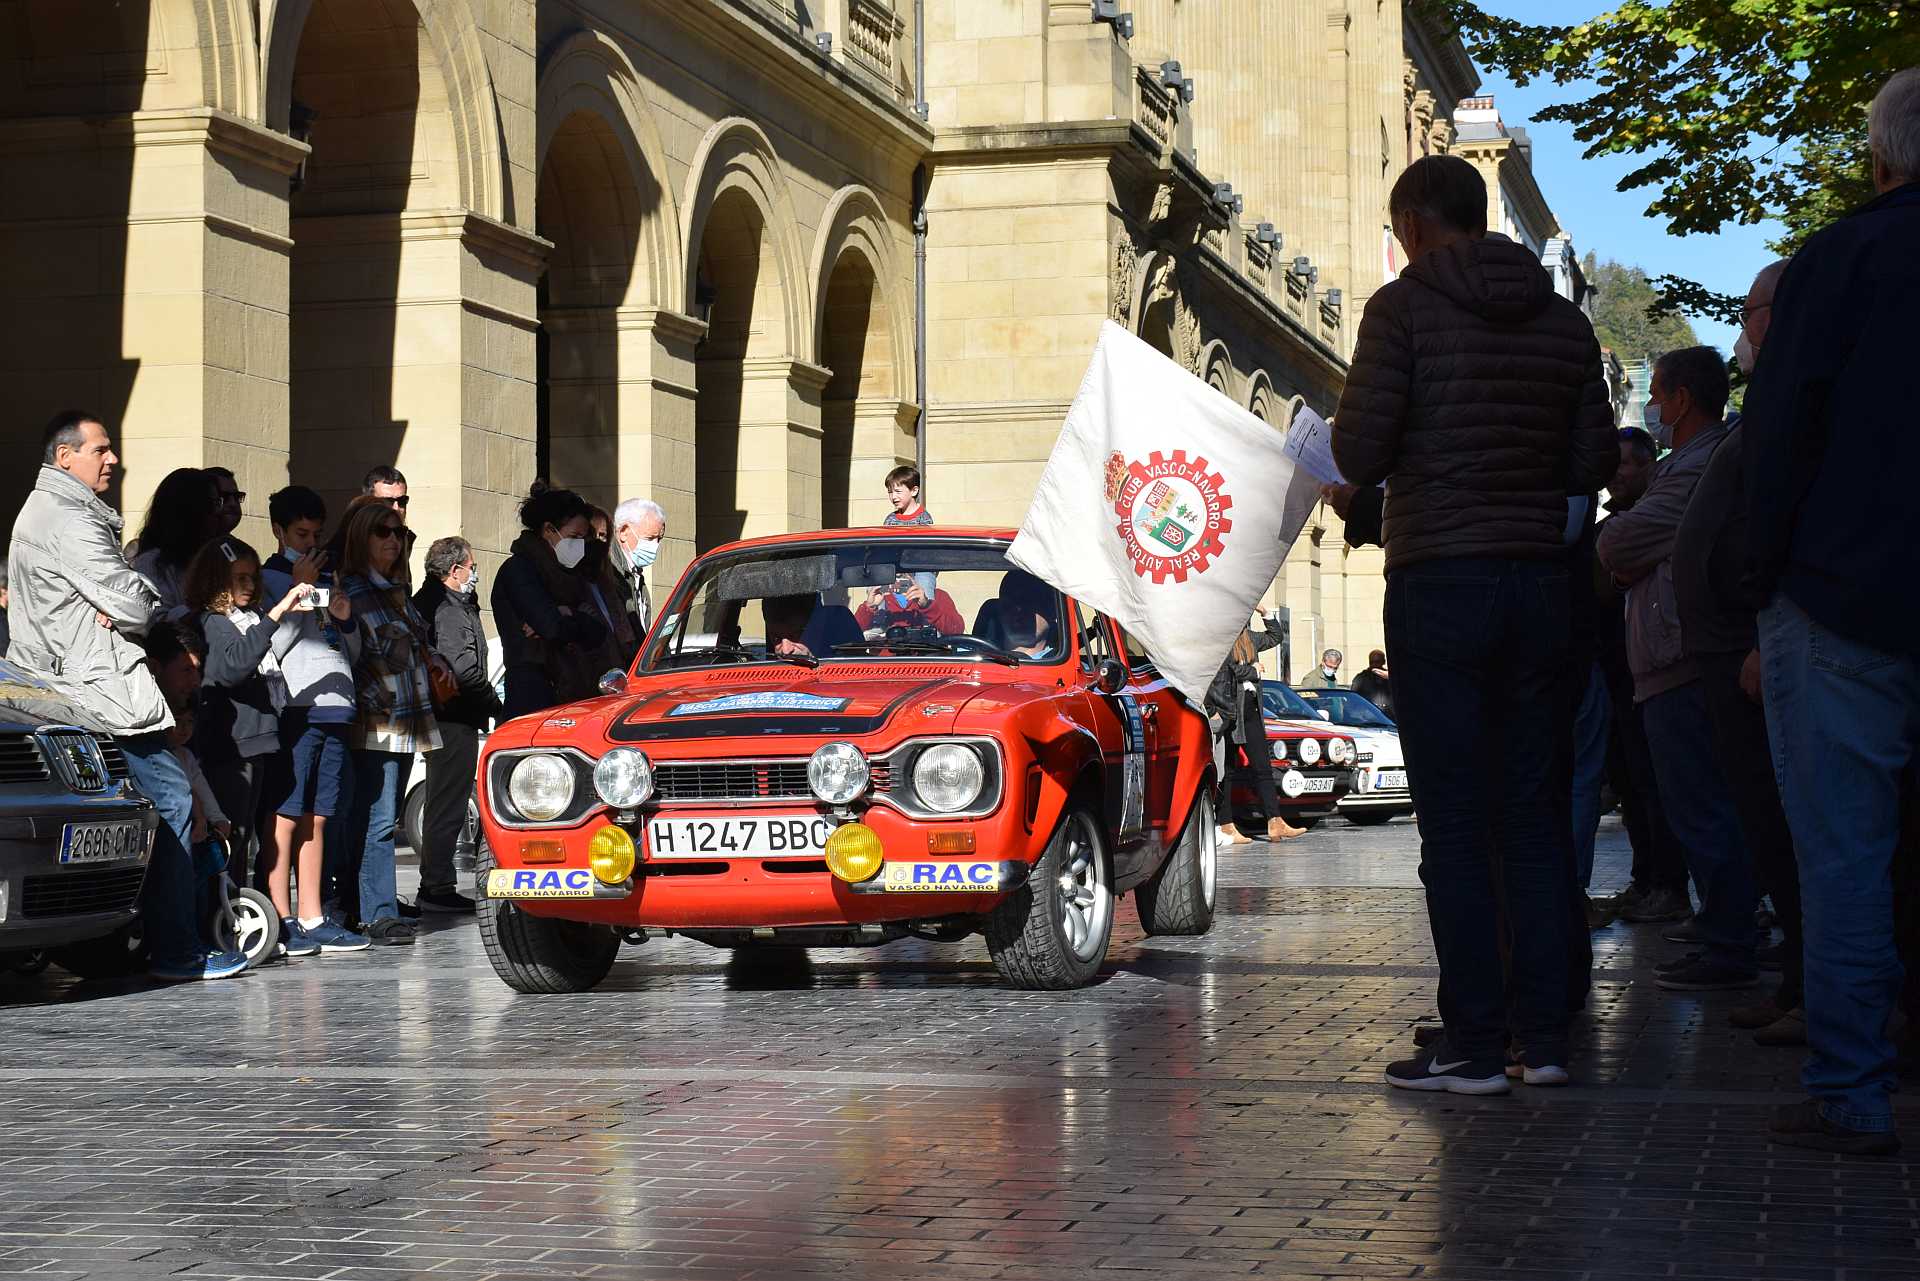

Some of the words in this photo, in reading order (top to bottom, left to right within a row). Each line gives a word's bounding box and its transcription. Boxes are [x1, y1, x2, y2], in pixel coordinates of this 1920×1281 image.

[1122, 477, 1144, 508] CLUB
[1122, 516, 1164, 571] AUTOMOVIL
[1171, 548, 1201, 571] REAL
[72, 827, 111, 858] 2696
[654, 822, 675, 852] H
[686, 821, 758, 852] 1247
[767, 820, 829, 851] BBC
[513, 870, 590, 889] RAC
[913, 863, 993, 884] RAC
